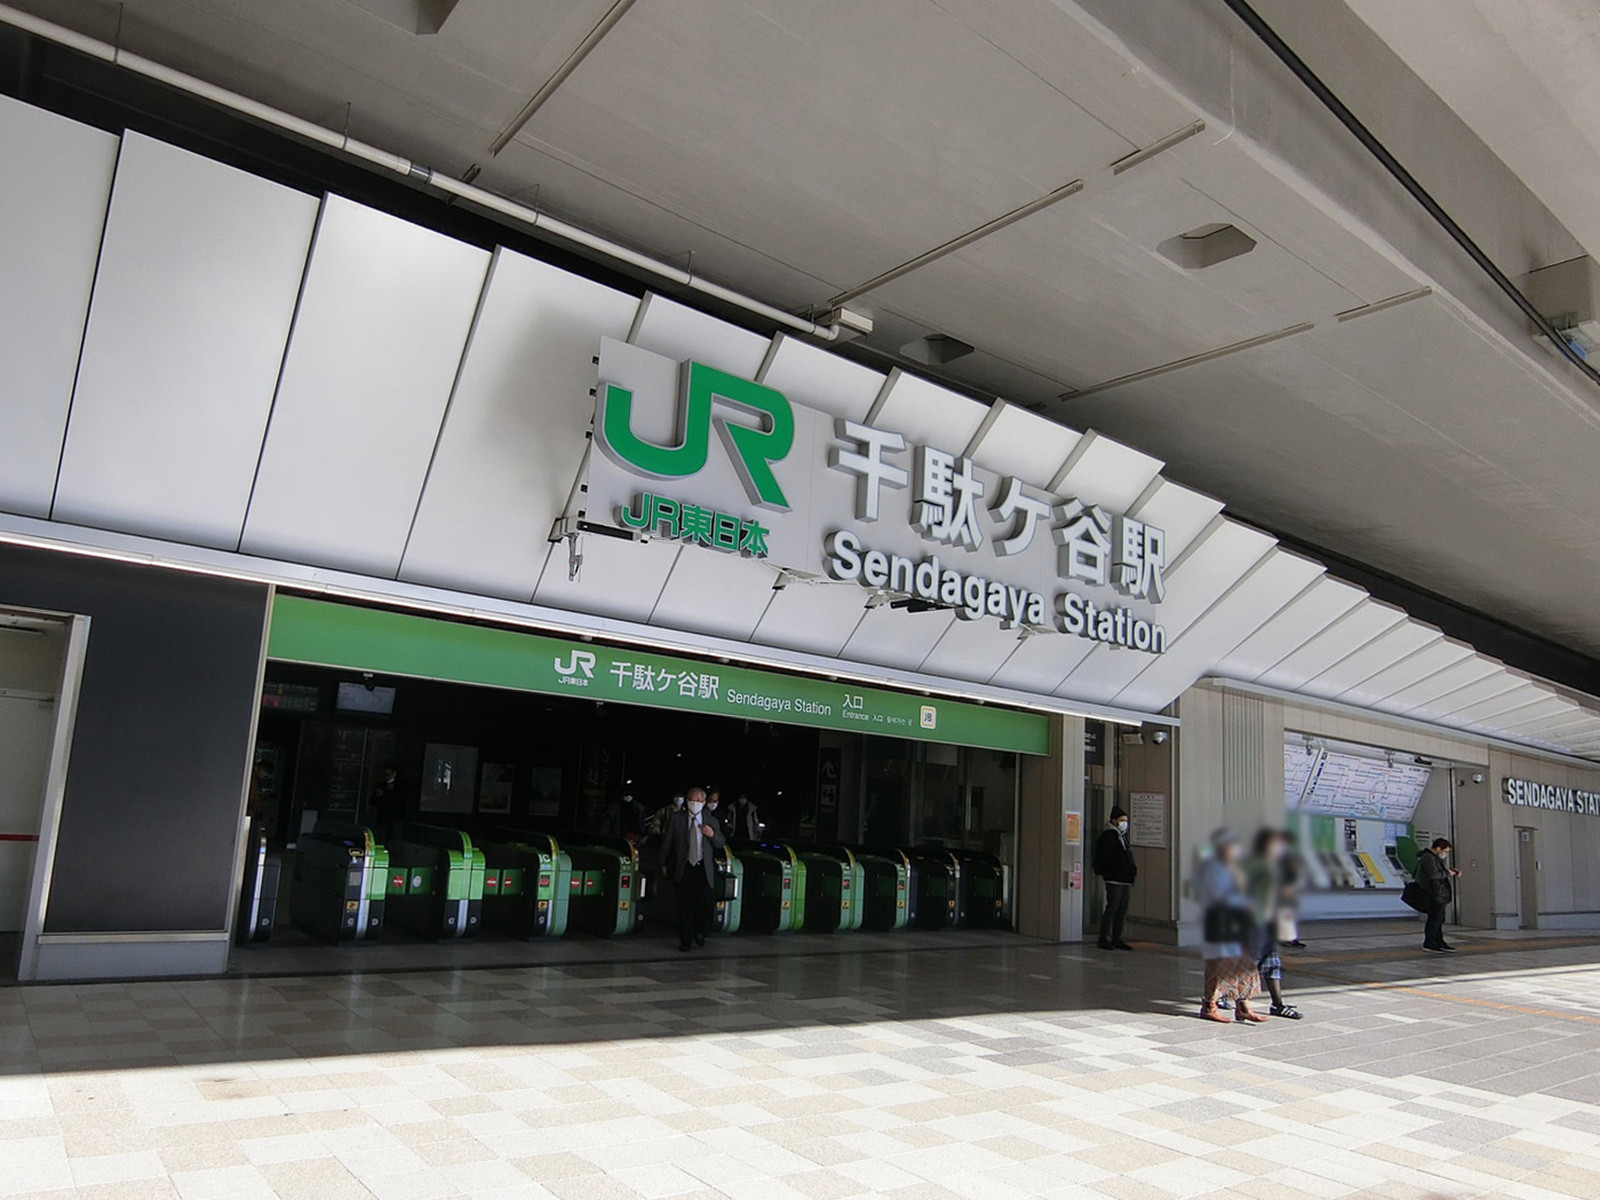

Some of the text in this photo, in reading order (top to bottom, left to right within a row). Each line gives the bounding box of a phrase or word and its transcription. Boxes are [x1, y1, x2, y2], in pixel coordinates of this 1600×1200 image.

[601, 360, 795, 509] JR
[620, 492, 770, 557] JR東日本
[828, 530, 1167, 654] Sendagaya Station
[554, 649, 596, 678] JR
[558, 676, 589, 686] JR東日本
[726, 688, 831, 716] Sendagaya Station
[842, 693, 864, 710] 入口
[842, 709, 869, 721] Entrance
[924, 712, 933, 722] JB
[1506, 778, 1576, 813] SENDAGAYA
